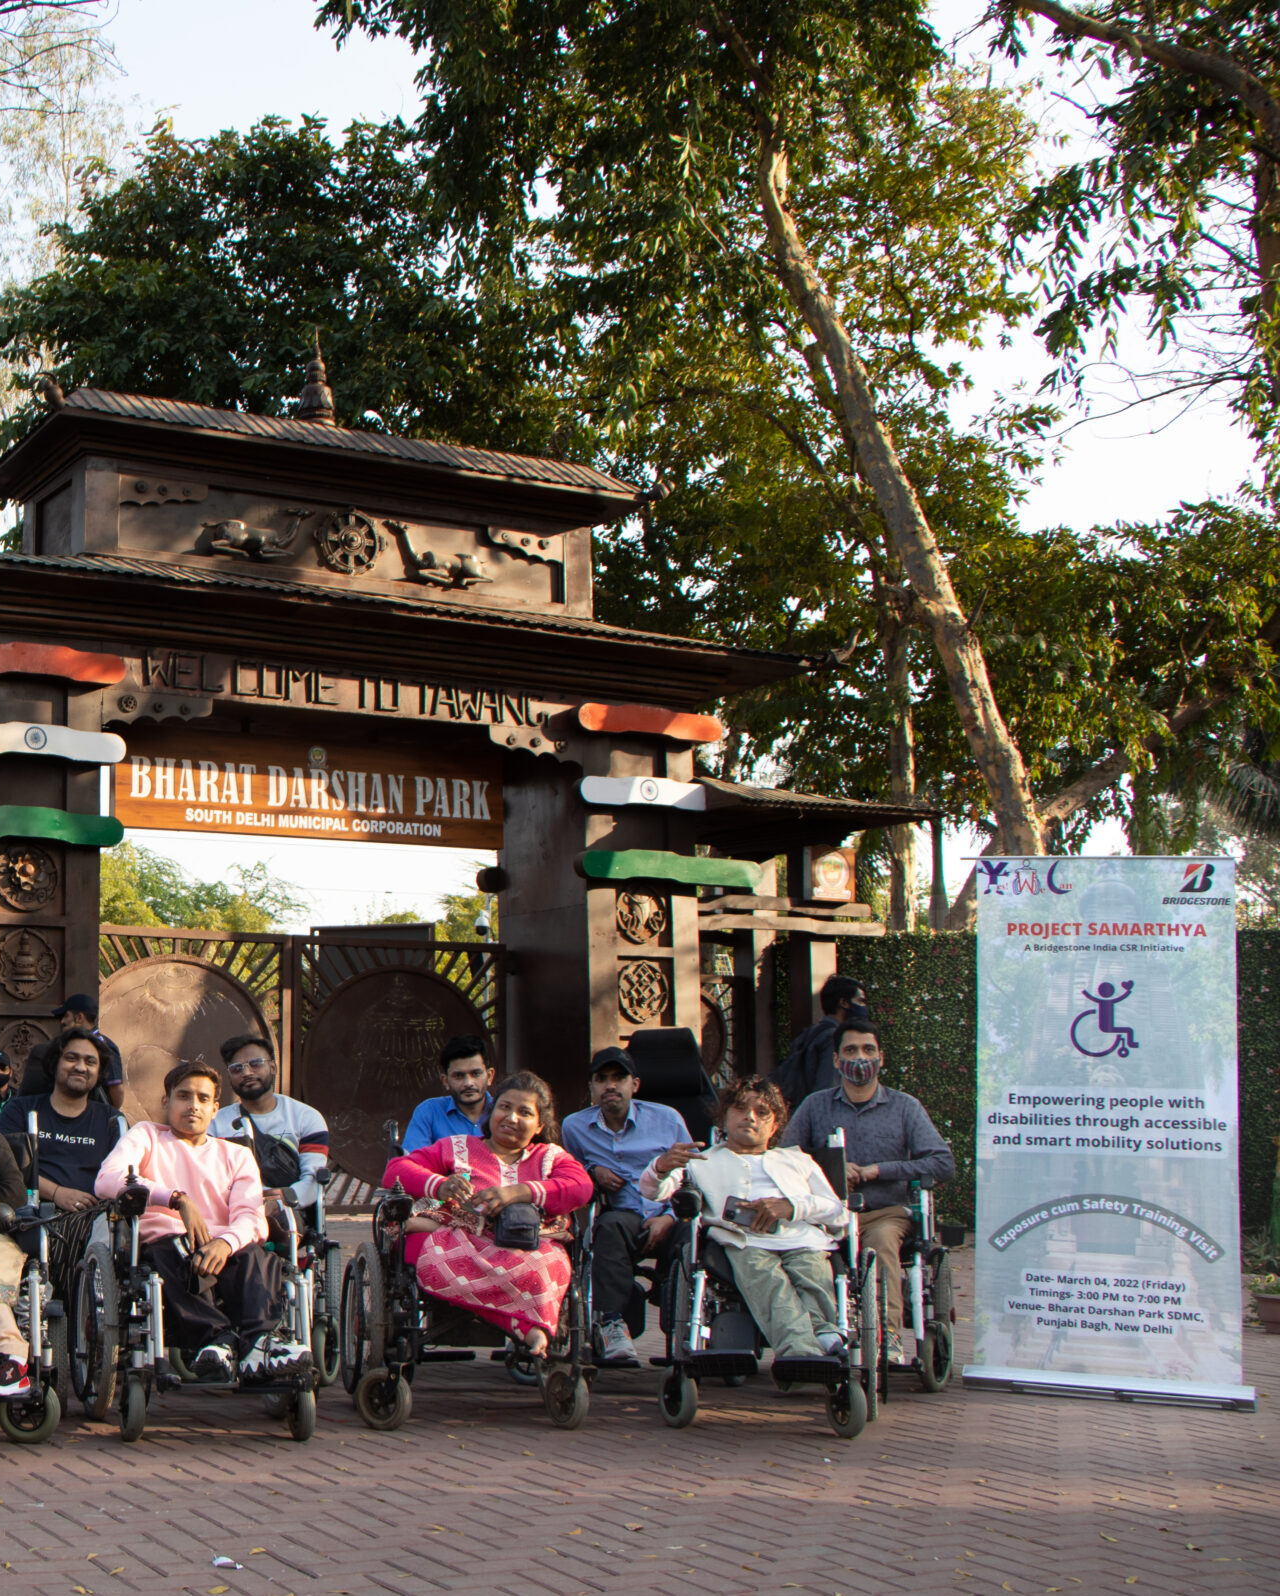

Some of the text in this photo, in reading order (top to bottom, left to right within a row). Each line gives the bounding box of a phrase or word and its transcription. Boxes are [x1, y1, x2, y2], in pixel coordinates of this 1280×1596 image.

[141, 647, 550, 728] WELCOME TO TAWANG
[130, 755, 492, 821] BHARAT DARSHAN PARK
[185, 808, 442, 837] SOUTH DELHI MUNICIPAL CORPORATION
[1161, 897, 1231, 906] BRIDGESTONE
[1007, 922, 1207, 940] PROJECT SAMARTHYA
[1024, 944, 1185, 953] A Bridgestone India CSR Initiative
[1008, 1093, 1205, 1111] Empowering people with
[987, 1112, 1227, 1131] disabilities through accessible
[39, 1131, 96, 1146] SK MASTER
[992, 1133, 1223, 1152] and smart mobility solutions
[994, 1199, 1218, 1259] Exposure cum Safety Training Visit
[1025, 1273, 1186, 1293] Date- March 04, 2022 (Friday)
[1029, 1288, 1181, 1305] Timings- 3:00 PM to 7:00 PM
[1008, 1301, 1045, 1311] Venue-
[1048, 1303, 1085, 1313] Bharat
[1088, 1306, 1134, 1317] Darshan
[1138, 1309, 1164, 1319] Park
[1036, 1317, 1077, 1329] Punjabi
[1114, 1322, 1139, 1332] New
[1143, 1324, 1173, 1334] Delhi
